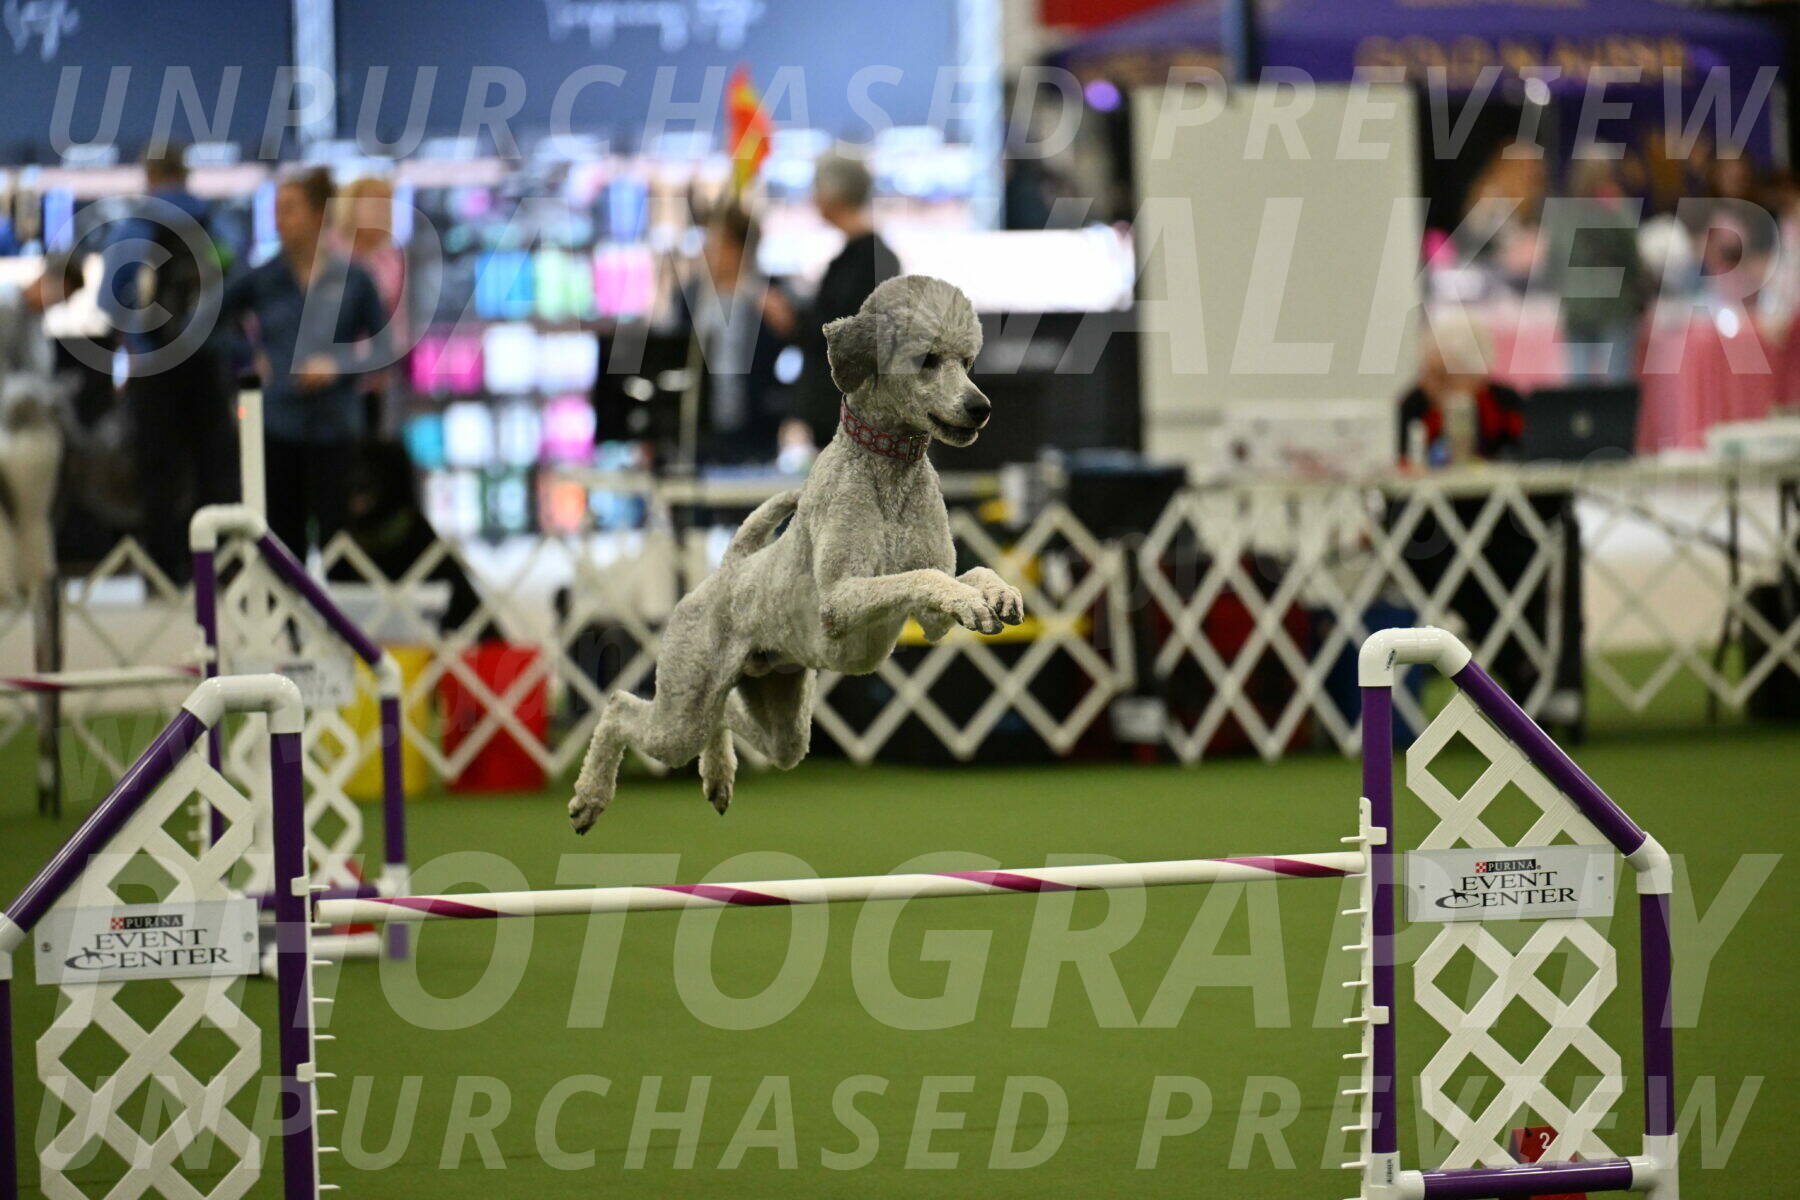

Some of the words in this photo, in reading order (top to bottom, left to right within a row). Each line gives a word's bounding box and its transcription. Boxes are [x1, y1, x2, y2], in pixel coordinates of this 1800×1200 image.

[1487, 860, 1535, 872] PURINA
[1461, 871, 1558, 891] EVENT
[1435, 886, 1578, 909] CENTER
[125, 915, 182, 930] PURINA
[94, 928, 208, 951] EVENT
[64, 946, 231, 971] CENTER
[1539, 1131, 1551, 1150] 2
